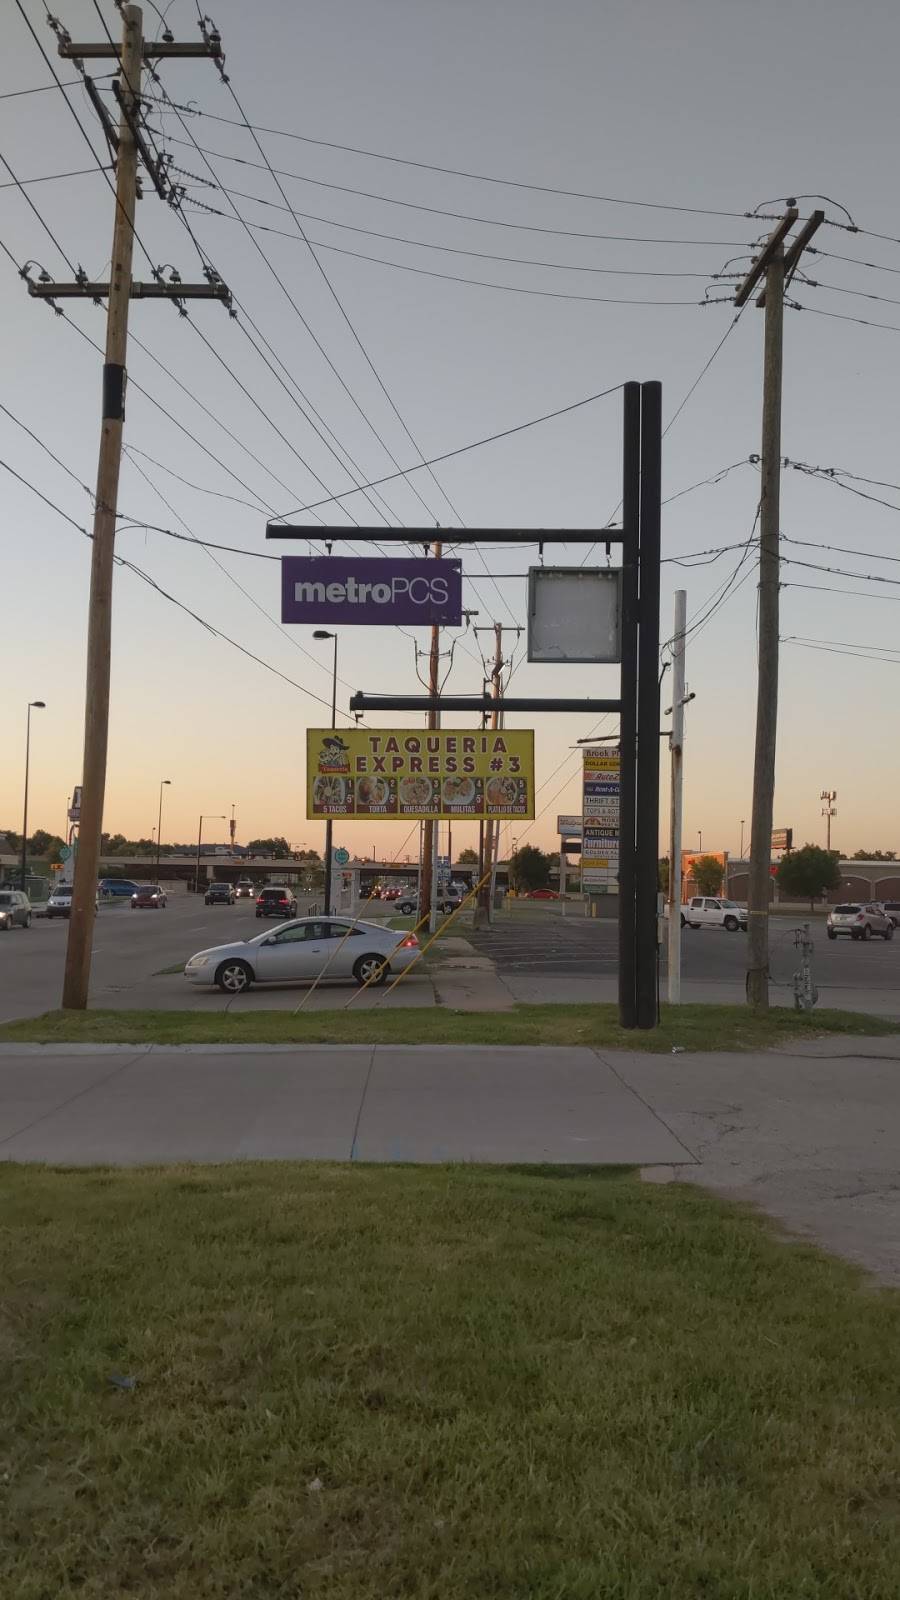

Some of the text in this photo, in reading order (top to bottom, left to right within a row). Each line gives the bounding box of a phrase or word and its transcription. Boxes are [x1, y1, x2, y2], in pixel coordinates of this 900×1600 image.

[294, 577, 449, 605] metroPCS
[368, 736, 508, 754] TAQUERIA
[355, 755, 521, 773] EXPRESS #3
[328, 805, 347, 813] TACOS
